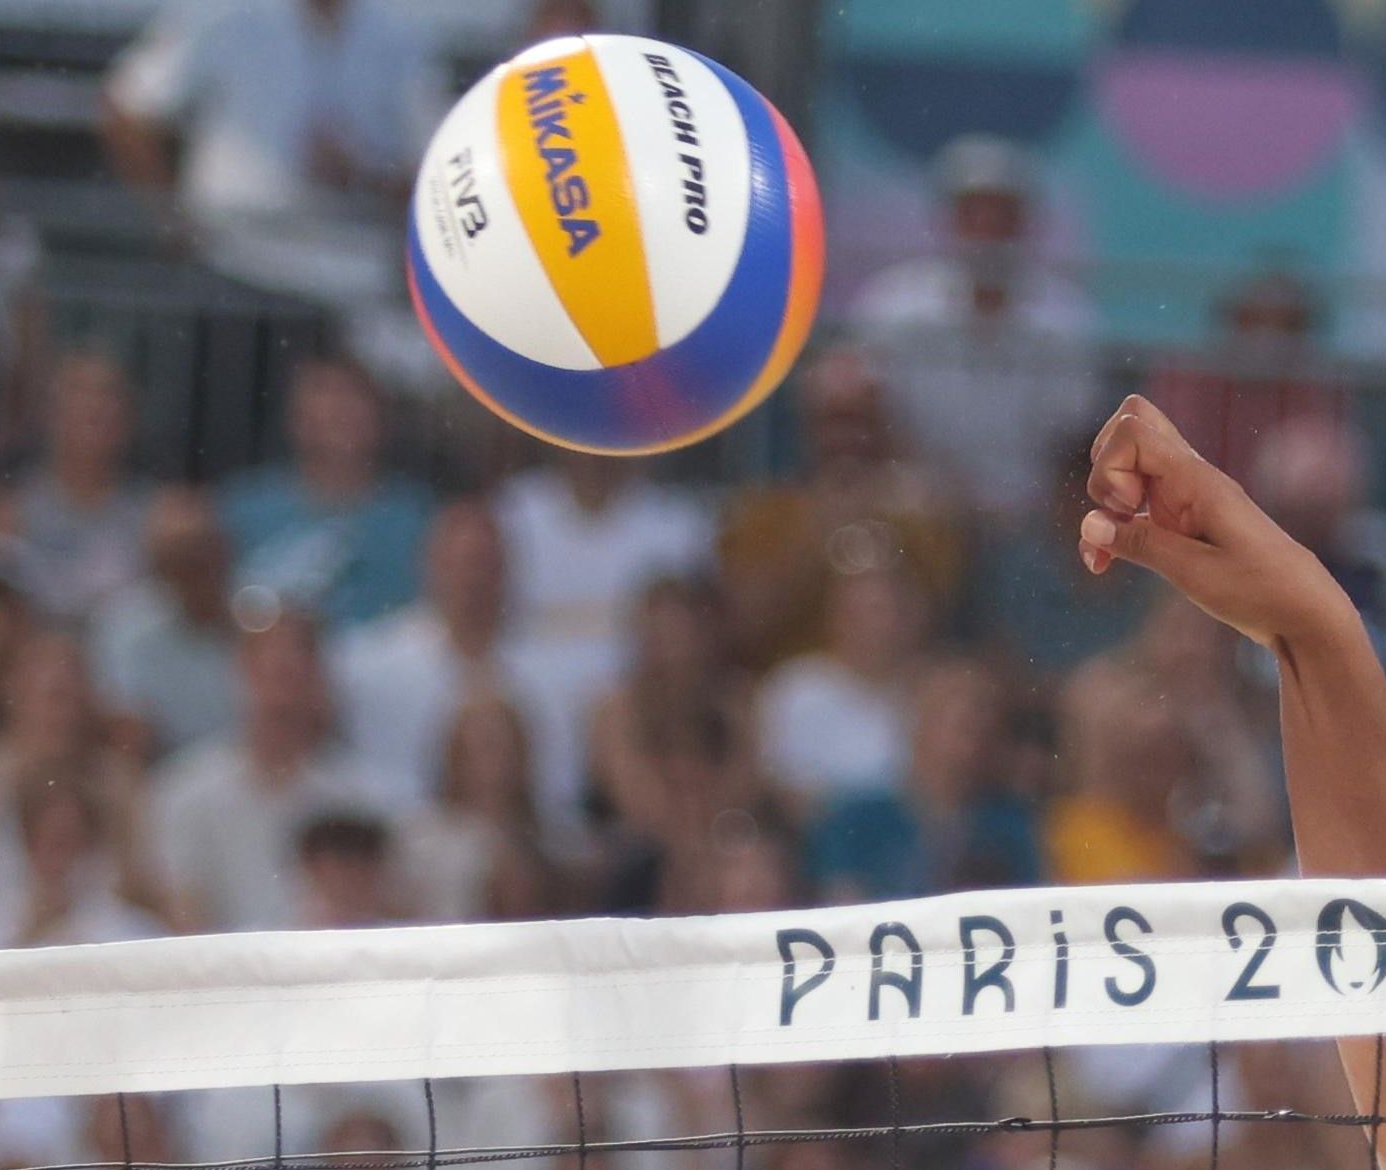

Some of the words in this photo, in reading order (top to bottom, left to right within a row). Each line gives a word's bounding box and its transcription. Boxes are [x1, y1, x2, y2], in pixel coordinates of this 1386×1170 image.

[524, 66, 602, 258] MIKASA
[642, 53, 700, 146] BEACH
[678, 152, 709, 235] PRO
